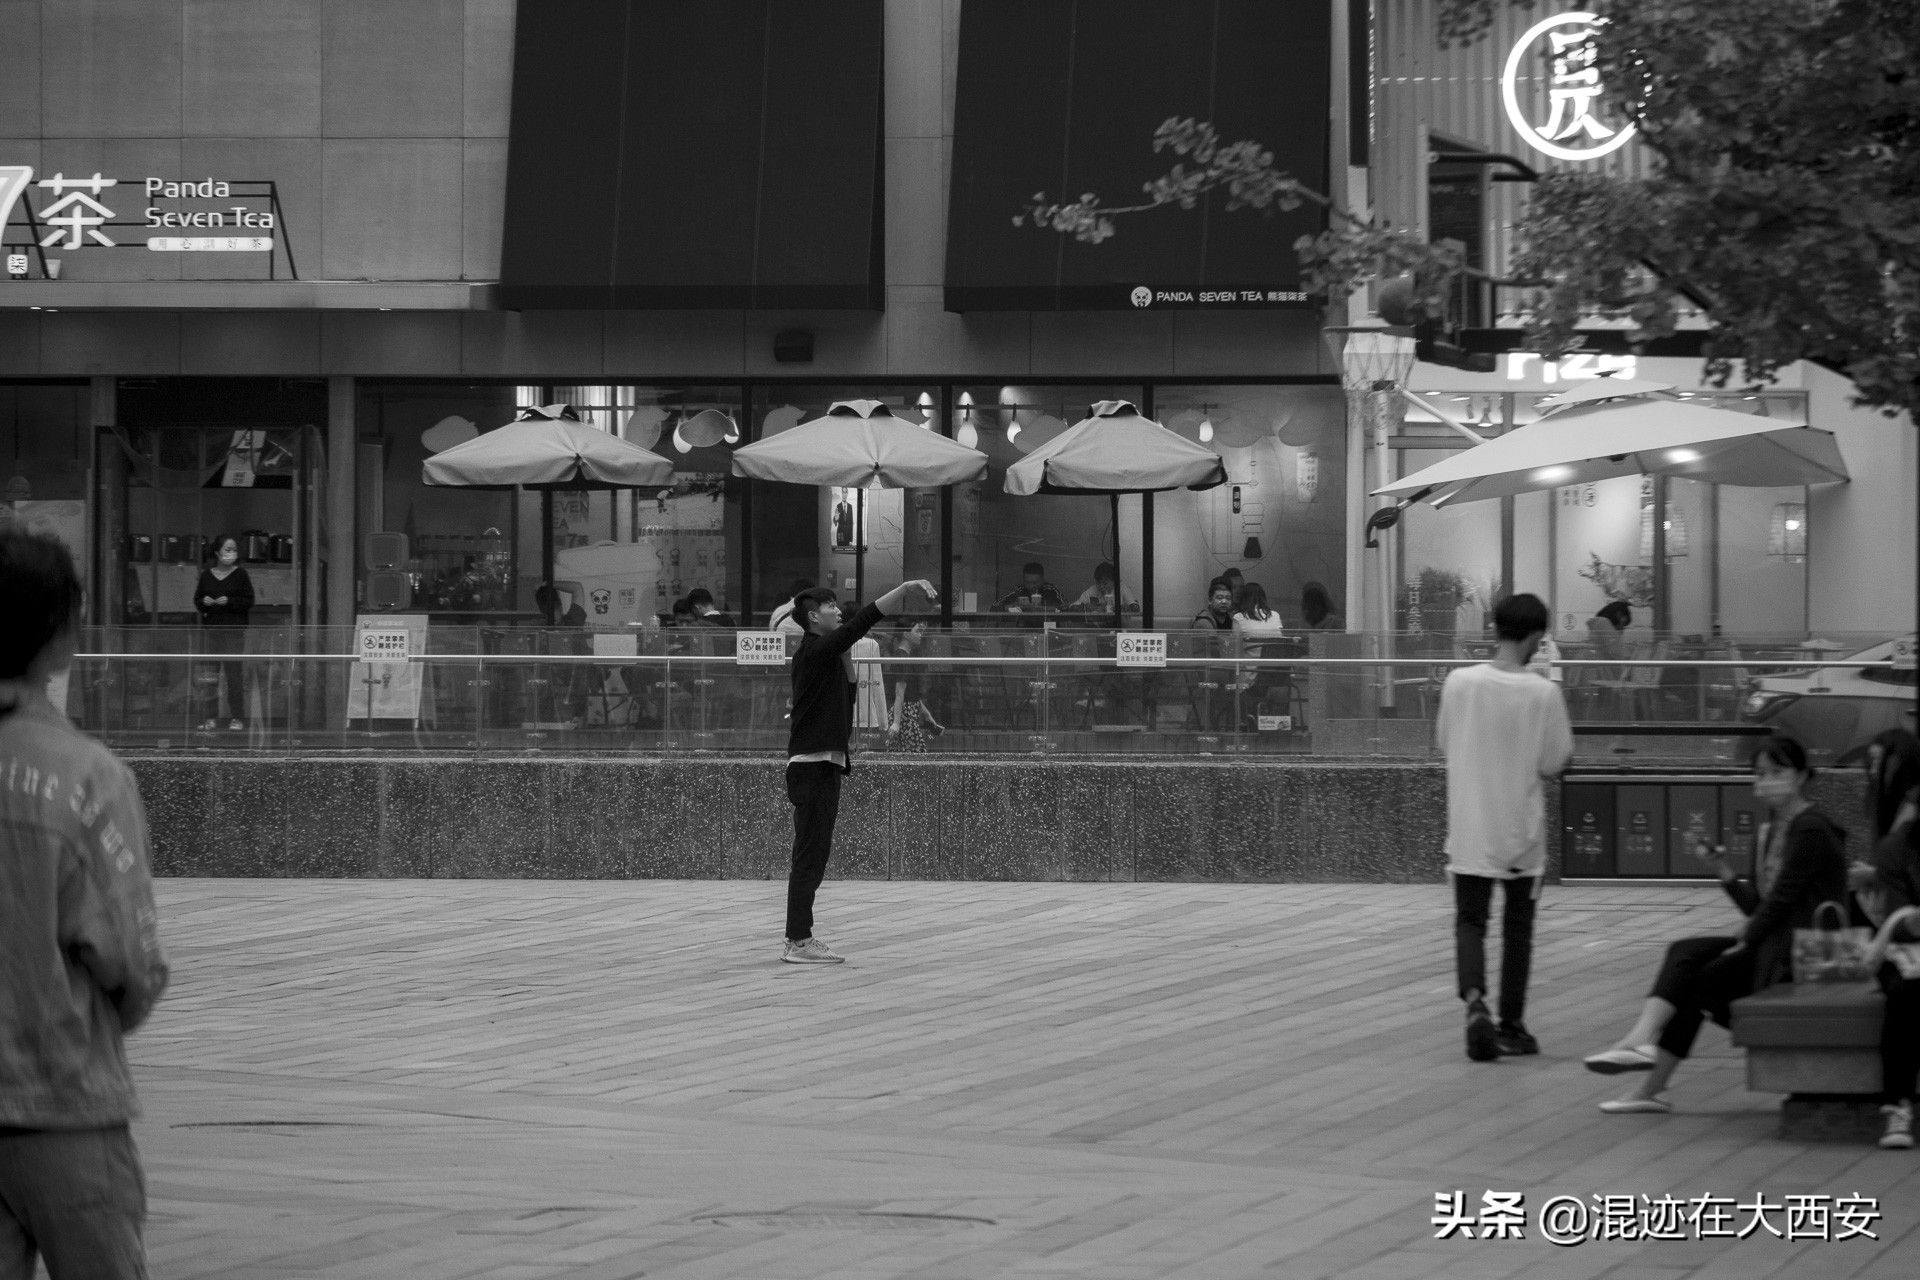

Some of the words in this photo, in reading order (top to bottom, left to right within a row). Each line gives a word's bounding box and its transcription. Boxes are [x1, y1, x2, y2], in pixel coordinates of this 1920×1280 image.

[145, 177, 230, 198] Panda
[145, 207, 223, 228] Seven
[229, 206, 274, 229] Tea
[1156, 291, 1194, 302] PANDA
[1199, 291, 1236, 302] SEVEN
[1240, 291, 1263, 302] TEA
[541, 501, 590, 513] EVEN
